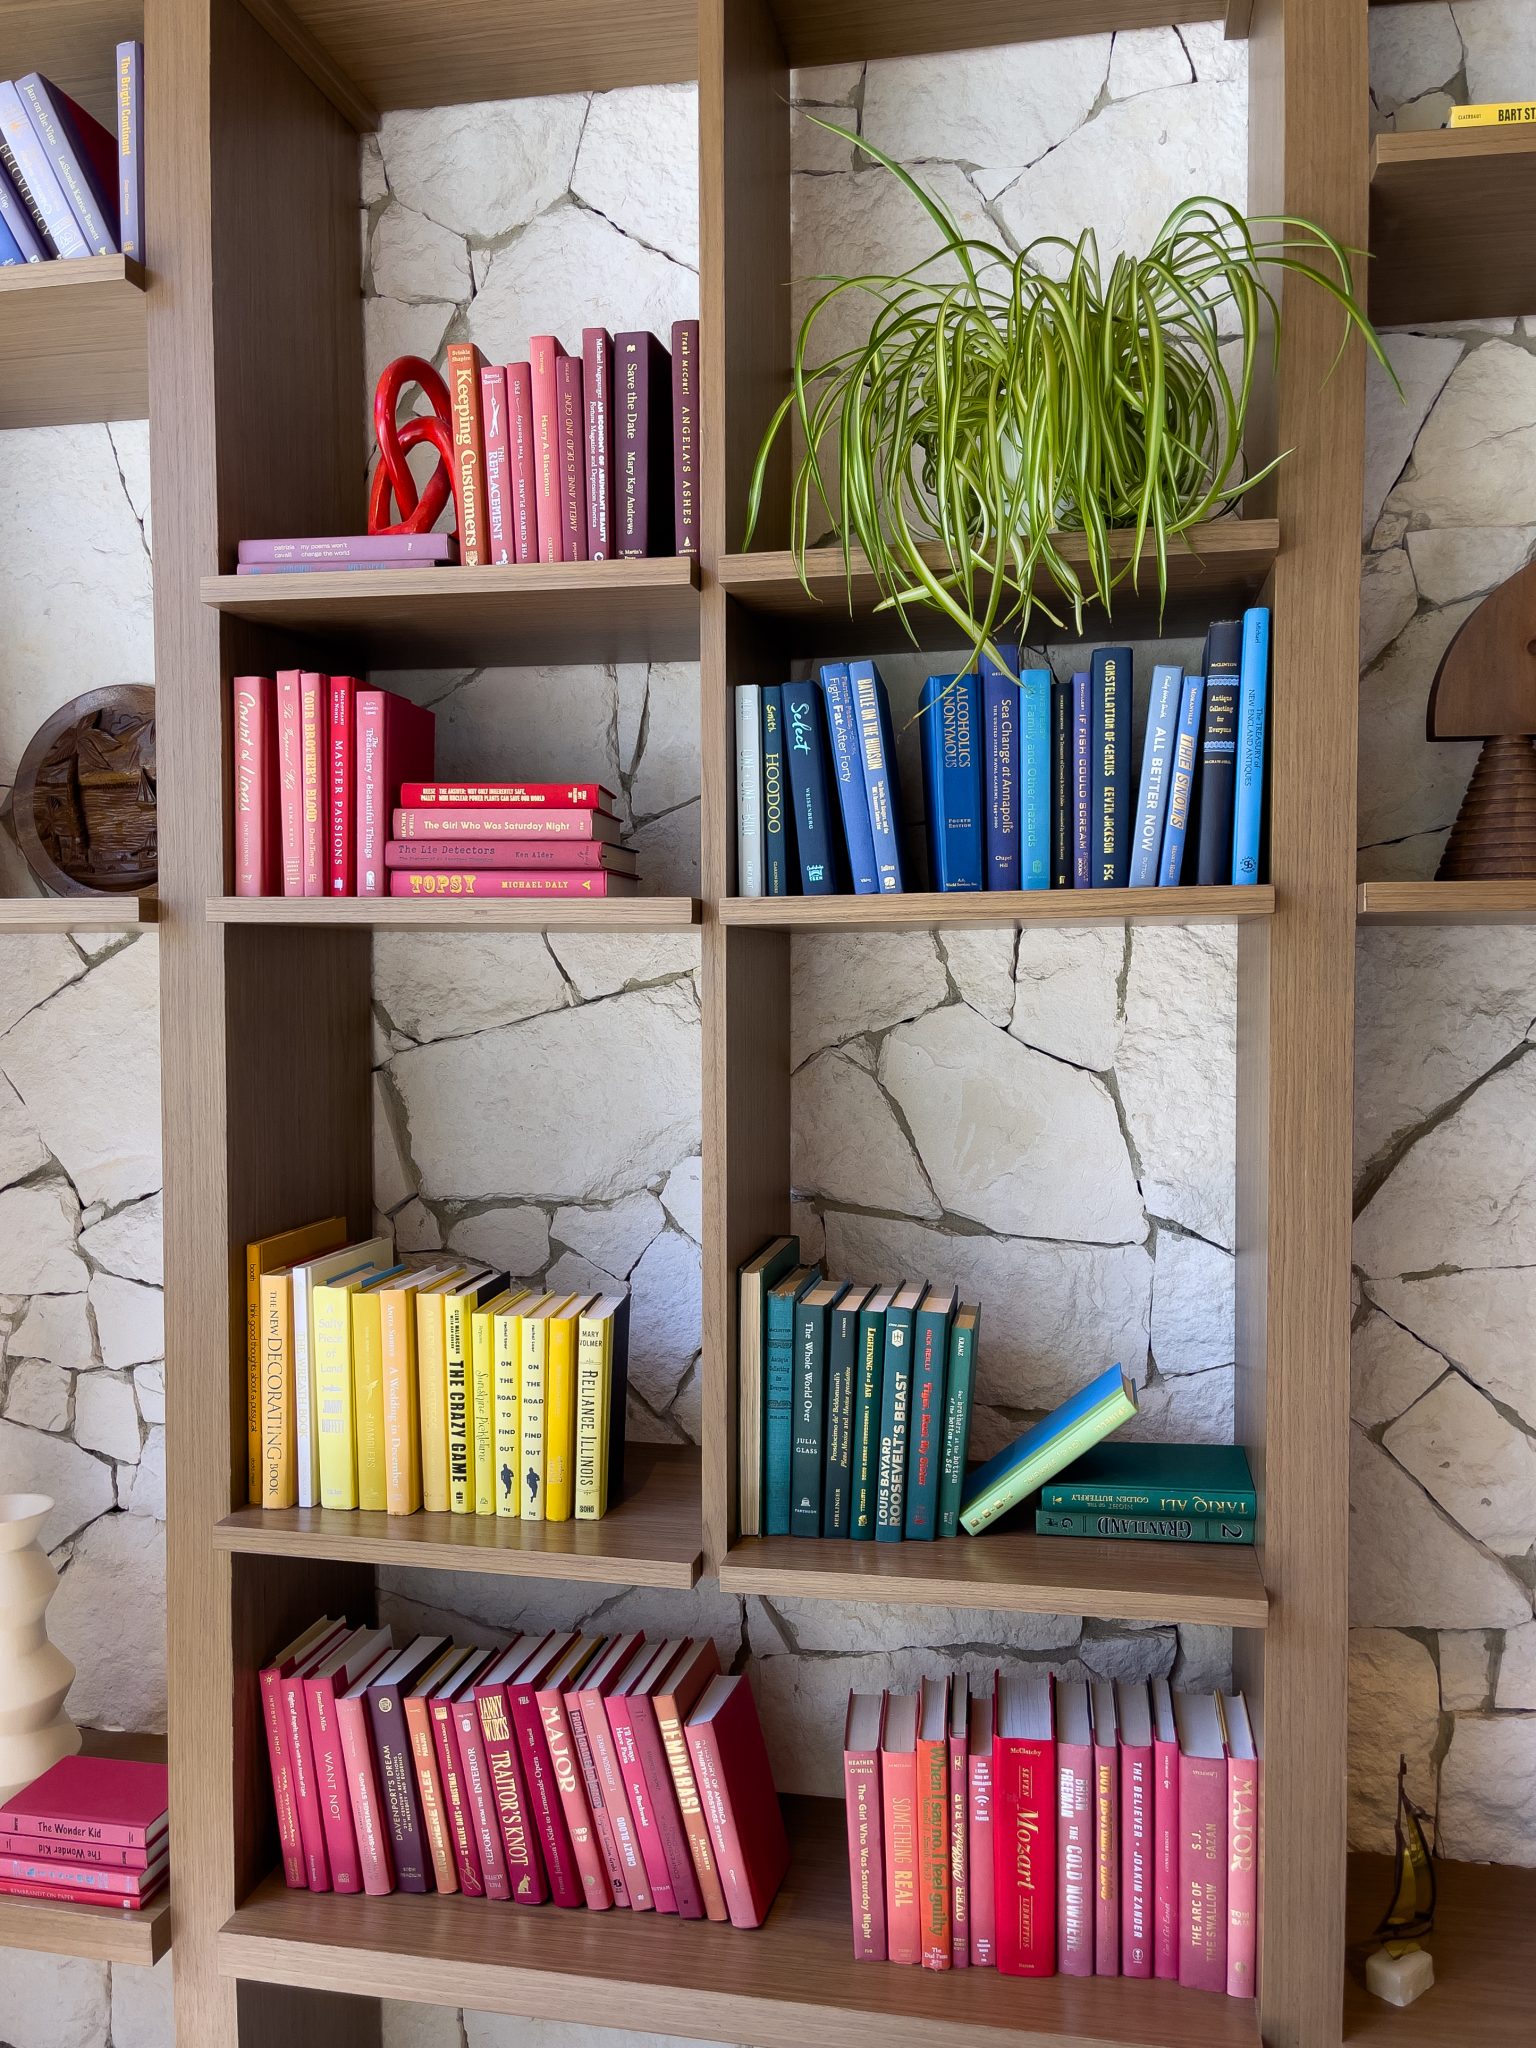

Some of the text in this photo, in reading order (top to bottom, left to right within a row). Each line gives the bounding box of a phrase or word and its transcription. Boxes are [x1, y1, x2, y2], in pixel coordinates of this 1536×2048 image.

[24, 84, 58, 145] Jam on the Vine
[120, 57, 131, 155] The Bright Continent
[1498, 108, 1522, 121] BART
[455, 369, 477, 546] Keeping Customers
[540, 415, 551, 497] Harry A. Blackmun
[589, 425, 597, 454] Magazine
[625, 363, 637, 534] Save the Date Mary Kay Andrews
[489, 451, 502, 540] REPLACEMENT
[590, 469, 598, 501] Depression
[828, 677, 852, 782] Fight Fat After Forty
[858, 678, 882, 770] BATTLE ON THE HUDSON
[943, 686, 956, 768] ANONYMOUS
[957, 686, 970, 767] ALCOHOLICS
[334, 740, 343, 865] MASTER PASSIONS
[766, 704, 781, 833] Smith HOODOO
[790, 702, 813, 830] Select WEISENBERG
[999, 700, 1013, 834] Sea Change at Annapolis
[1103, 660, 1115, 880] CONSTELLATION OF GENIUS KEVIN JACKSON FSG
[1141, 727, 1166, 851] ALL BETTER NOW
[399, 845, 495, 855] The Lie Detectors
[424, 822, 569, 831] The Girl Who Was Saturday Night
[409, 875, 568, 894] TOPSY MICHAEL DALY
[248, 1320, 257, 1340] good
[249, 1304, 258, 1318] think
[269, 1310, 278, 1335] NEW
[248, 1342, 258, 1371] thoughts
[250, 1373, 258, 1393] about
[803, 1322, 813, 1422] The Whole World Over
[249, 1402, 257, 1432] pussycat
[267, 1338, 282, 1460] DECORATING
[449, 1361, 467, 1482] THE CRAZY GAME
[580, 1370, 599, 1486] RELIANCE, ILLINOIS
[269, 1463, 278, 1496] BOOK
[879, 1438, 891, 1526] LOUIS BAYARD
[891, 1372, 907, 1526] ROOSEVELT'S BEAST
[1071, 1494, 1149, 1504] GOLDEN BUTTERFLY
[1097, 1517, 1191, 1539] GRANTLAND
[1160, 1498, 1248, 1512] TARIQ ALI
[324, 1752, 341, 1821] WANT NOT
[448, 1772, 460, 1805] CHRISTMAS
[468, 1747, 482, 1794] INTERIOR
[542, 1706, 576, 1792] MAJOR
[659, 1718, 700, 1814] DEMOKRASI
[1022, 1768, 1030, 1797] SEVEN
[38, 1822, 101, 1838] The Wonder Kid
[382, 1745, 403, 1840] DAVENPORT'S DREAM
[454, 1811, 468, 1848] TWELVE DAYS
[479, 1809, 487, 1825] FROM
[490, 1750, 528, 1866] TRAITOR'S KNOT
[1060, 1768, 1074, 1818] FREEMAN
[1075, 1778, 1088, 1810] BRIAN
[1232, 1775, 1252, 1872] MAJOR
[39, 1845, 101, 1860] The Wonder Kid
[482, 1828, 495, 1865] REPORT
[857, 1784, 871, 1938] The Girl Who Was Saturday Night
[892, 1798, 913, 1907] SOMETHING REAL
[1016, 1804, 1039, 1890] Mozart
[1133, 1762, 1143, 1938] THE BELIEVER JOAKIM ZANDER
[1192, 1830, 1202, 1850] S.J.
[1206, 1824, 1216, 1860] GAZAN
[1066, 1825, 1083, 1952] THE COLD NOWHERE
[1192, 1882, 1202, 1947] THE ARC OF
[1205, 1884, 1216, 1963] THE SWALLOW
